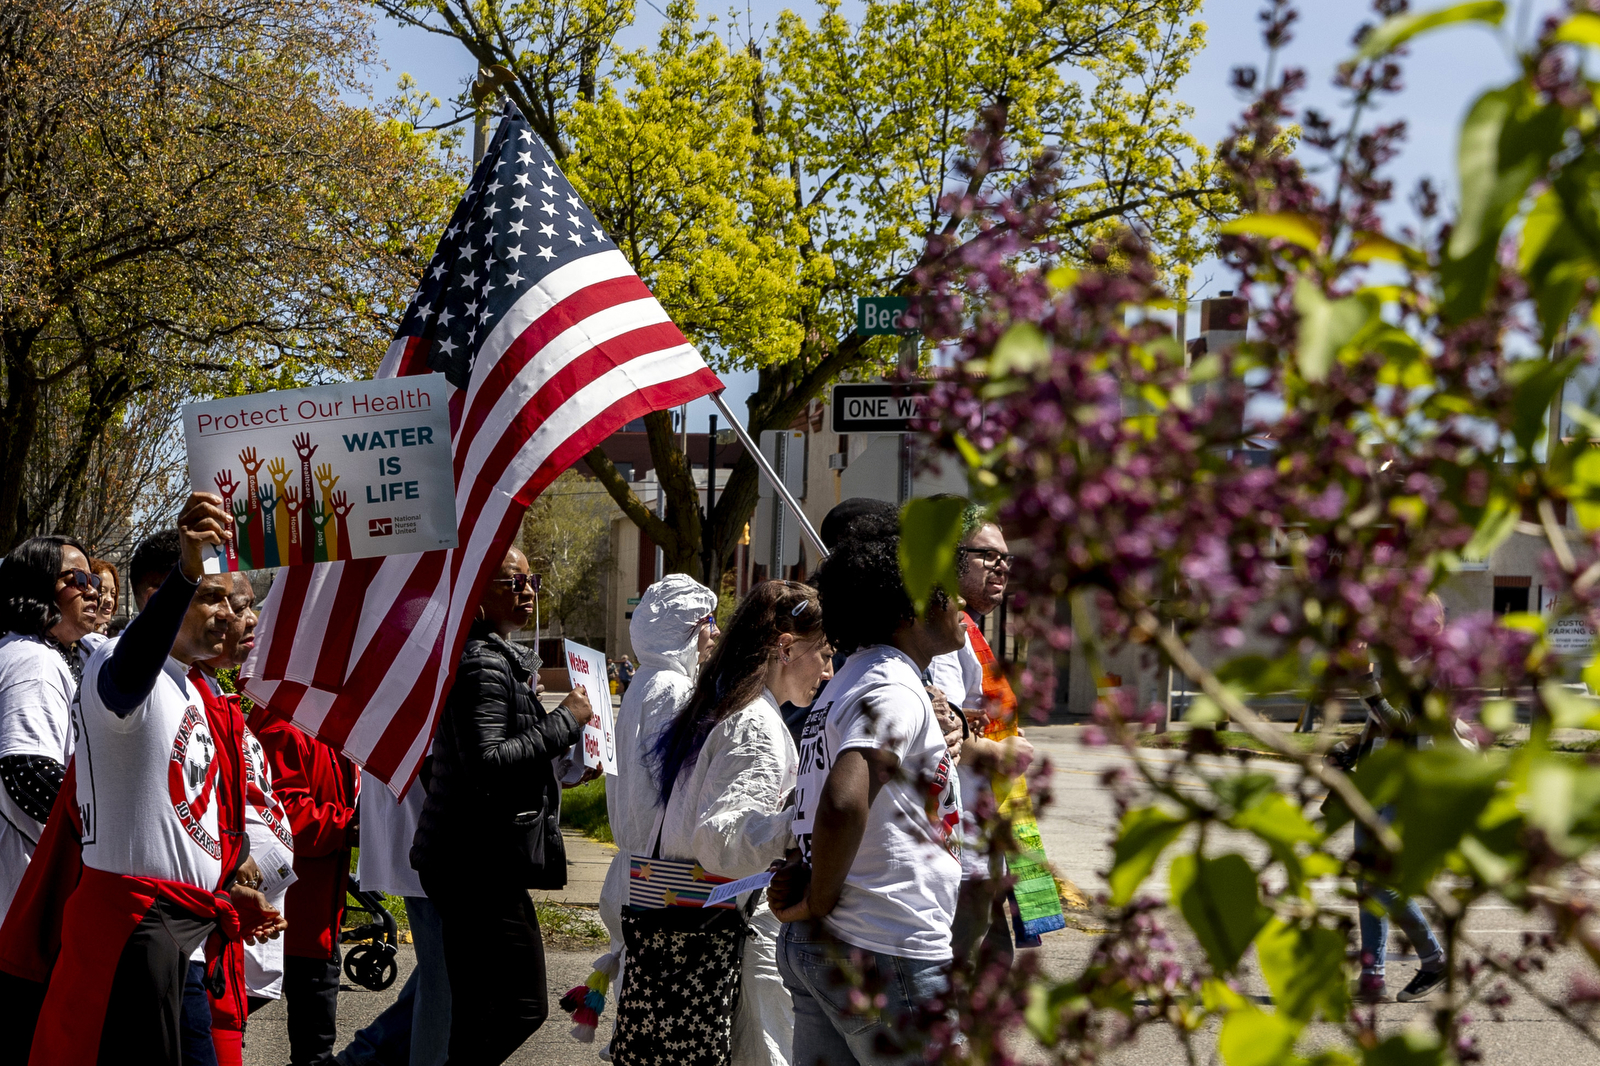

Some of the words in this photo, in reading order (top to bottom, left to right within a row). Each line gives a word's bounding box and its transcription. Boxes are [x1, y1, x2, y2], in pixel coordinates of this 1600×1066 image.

[864, 303, 902, 329] Bea
[197, 404, 288, 433] Protect
[297, 399, 343, 420] Our
[352, 388, 431, 414] Health
[849, 399, 889, 418] ONE
[897, 398, 927, 417] WA
[342, 426, 434, 452] WATER
[378, 456, 402, 477] IS
[303, 461, 311, 498] Healthcare
[365, 480, 420, 504] LIFE
[394, 513, 422, 522] National
[394, 520, 417, 529] Nurses
[394, 526, 417, 535] United
[1557, 619, 1585, 627] CUSTO
[568, 651, 589, 675] Water
[261, 808, 273, 824] 10
[176, 801, 191, 820] 10
[185, 817, 215, 855] YEARS
